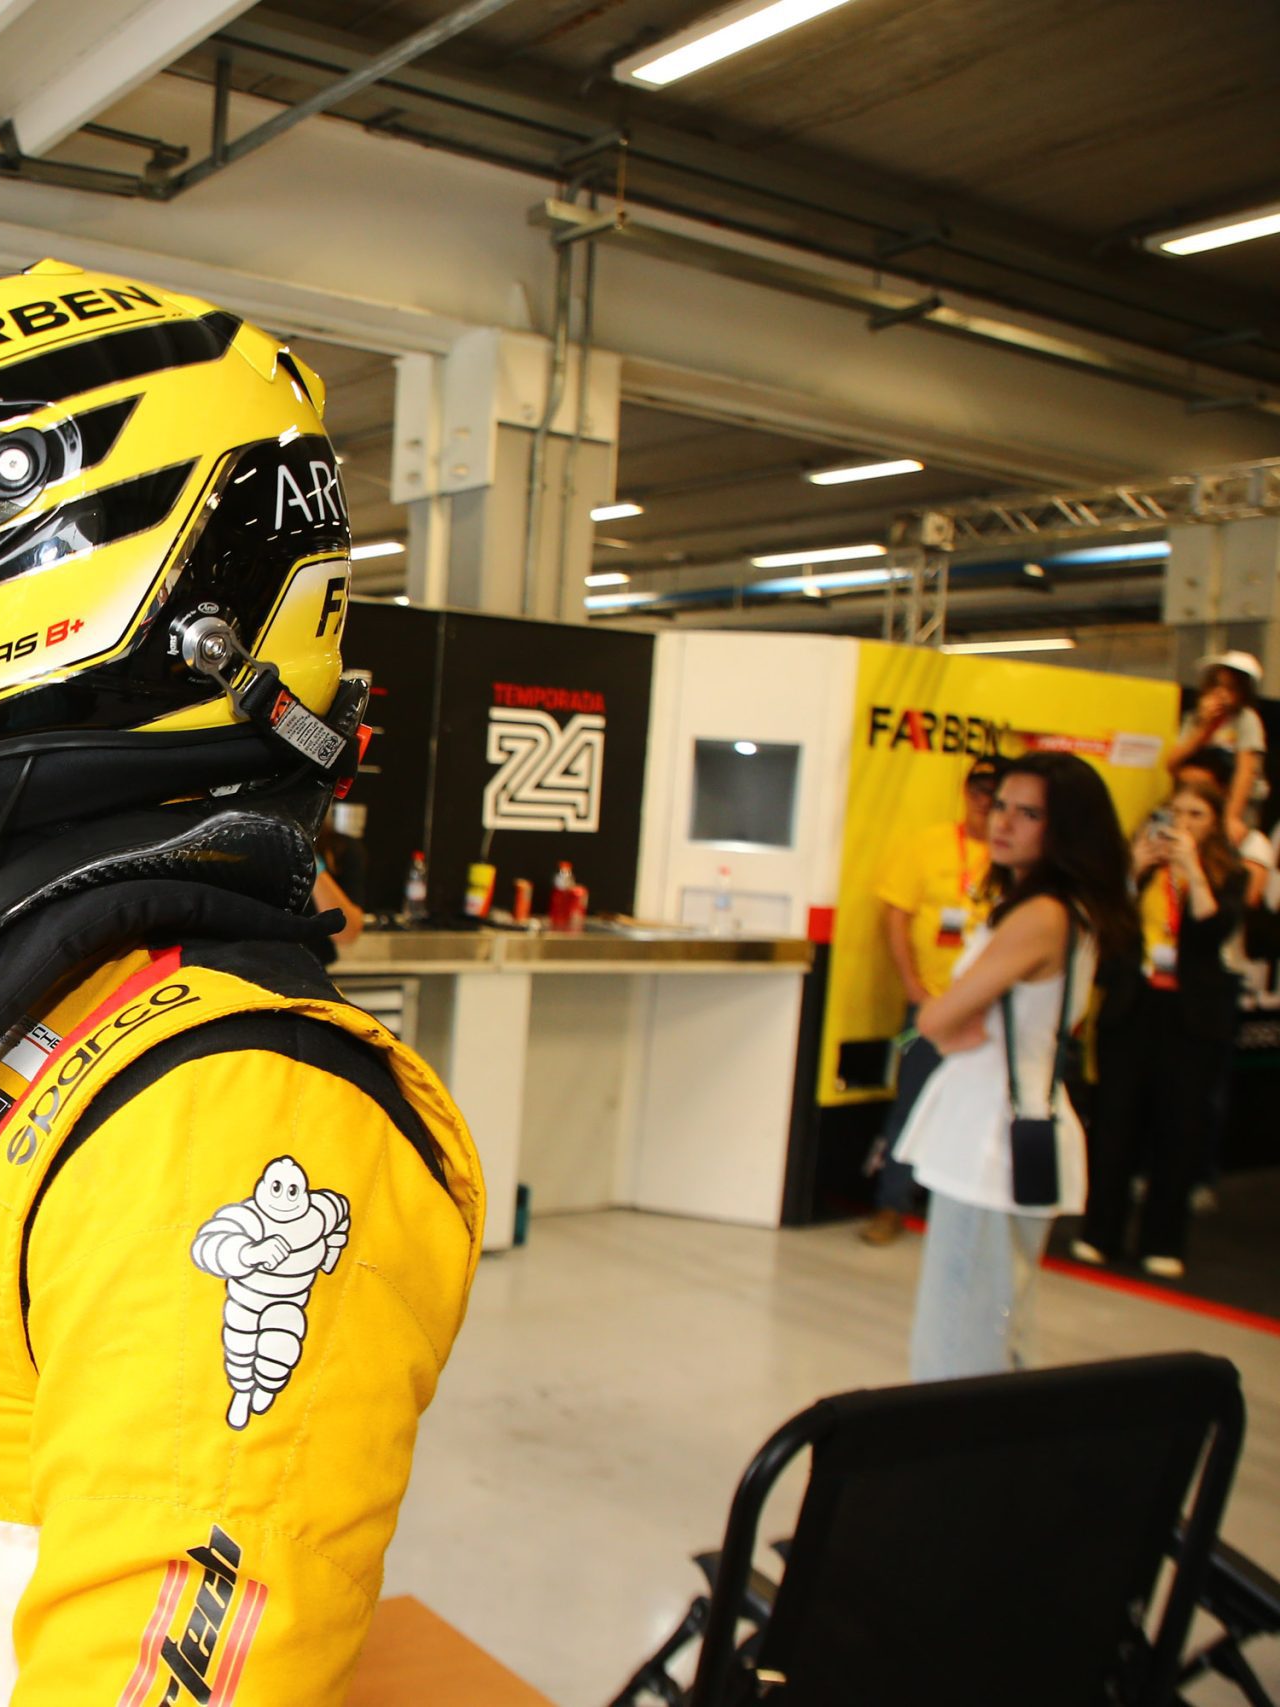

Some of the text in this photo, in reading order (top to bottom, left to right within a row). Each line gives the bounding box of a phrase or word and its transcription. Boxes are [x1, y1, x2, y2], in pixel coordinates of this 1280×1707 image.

[45, 618, 85, 648] B+
[493, 682, 607, 713] TEMPORADA
[6, 983, 190, 1166] sparco
